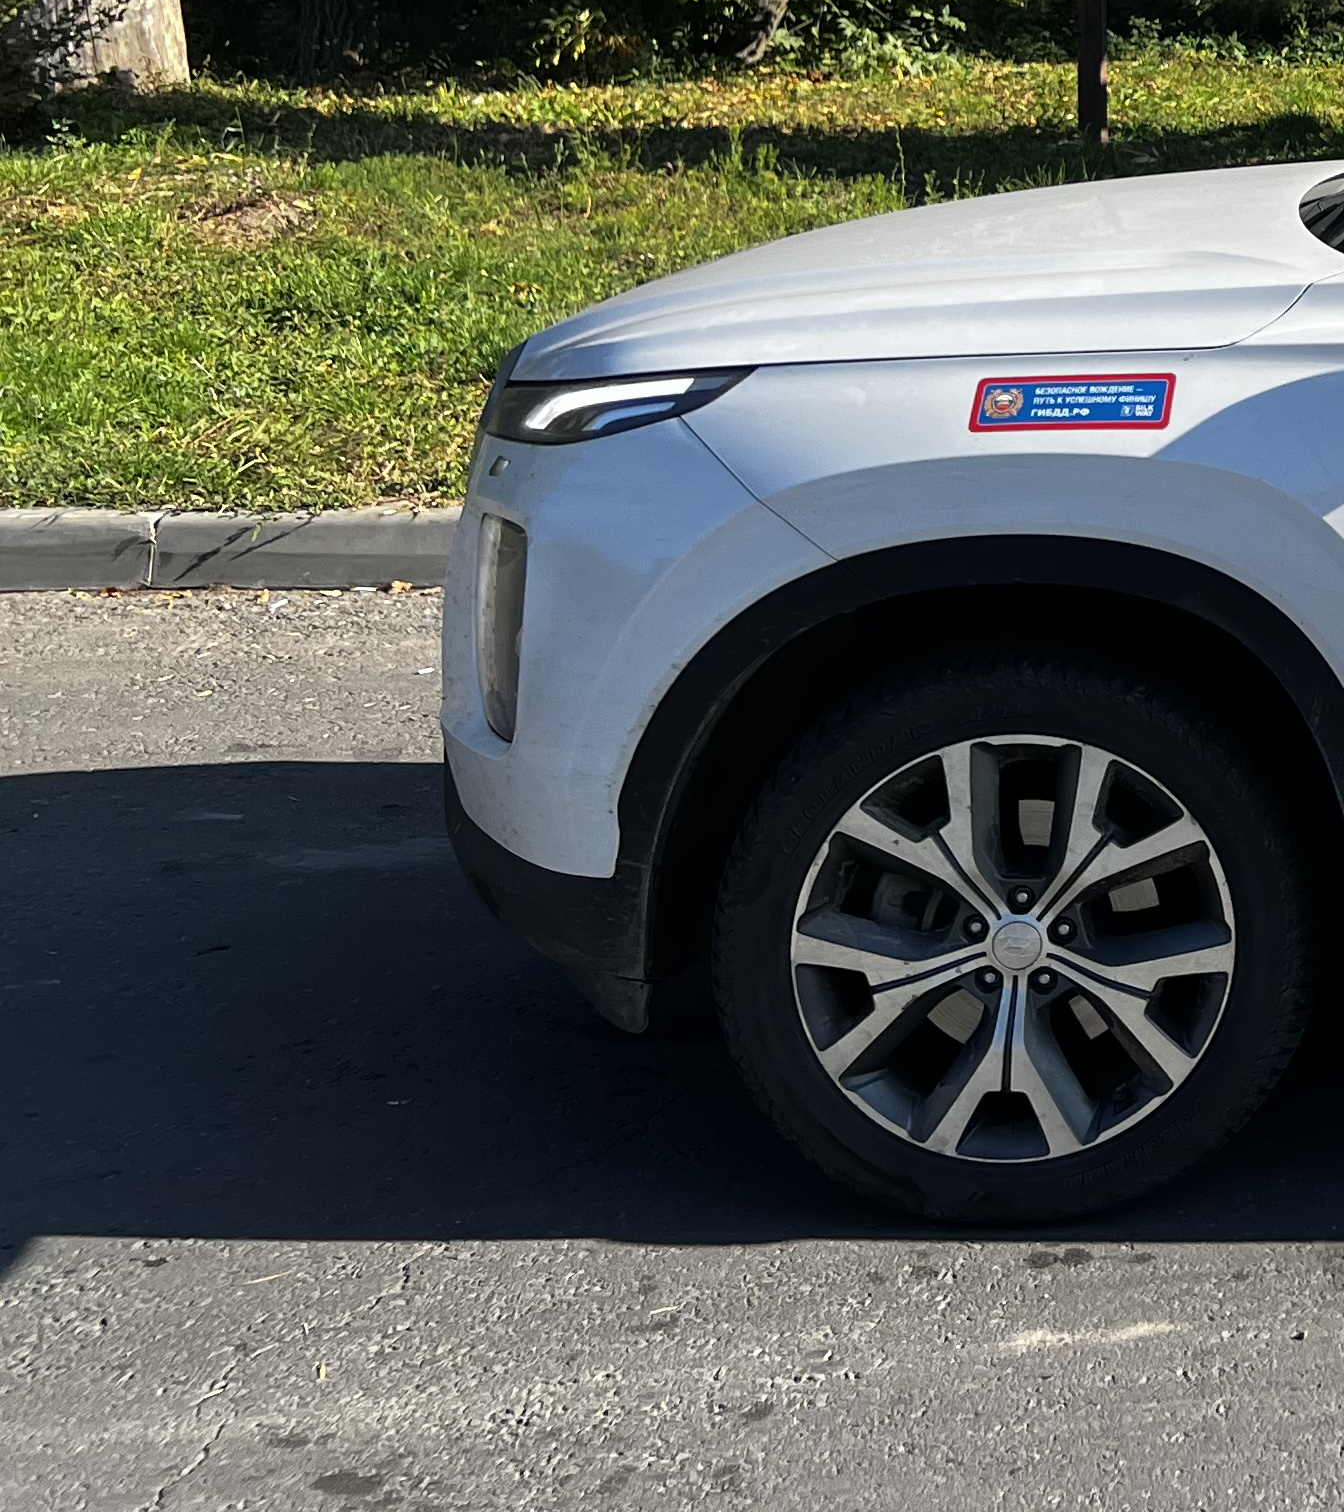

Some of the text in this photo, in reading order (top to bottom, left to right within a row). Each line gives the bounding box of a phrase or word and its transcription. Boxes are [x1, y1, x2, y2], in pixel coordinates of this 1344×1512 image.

[1034, 385, 1087, 395] БЕЗОПАСНОЕ
[1089, 385, 1135, 395] ВОЖДЕНИЕ
[1033, 396, 1056, 405] ПУТЬ
[1065, 395, 1117, 404] УСПЕШНОМУ
[1030, 407, 1090, 418] ГИБДД.РФ
